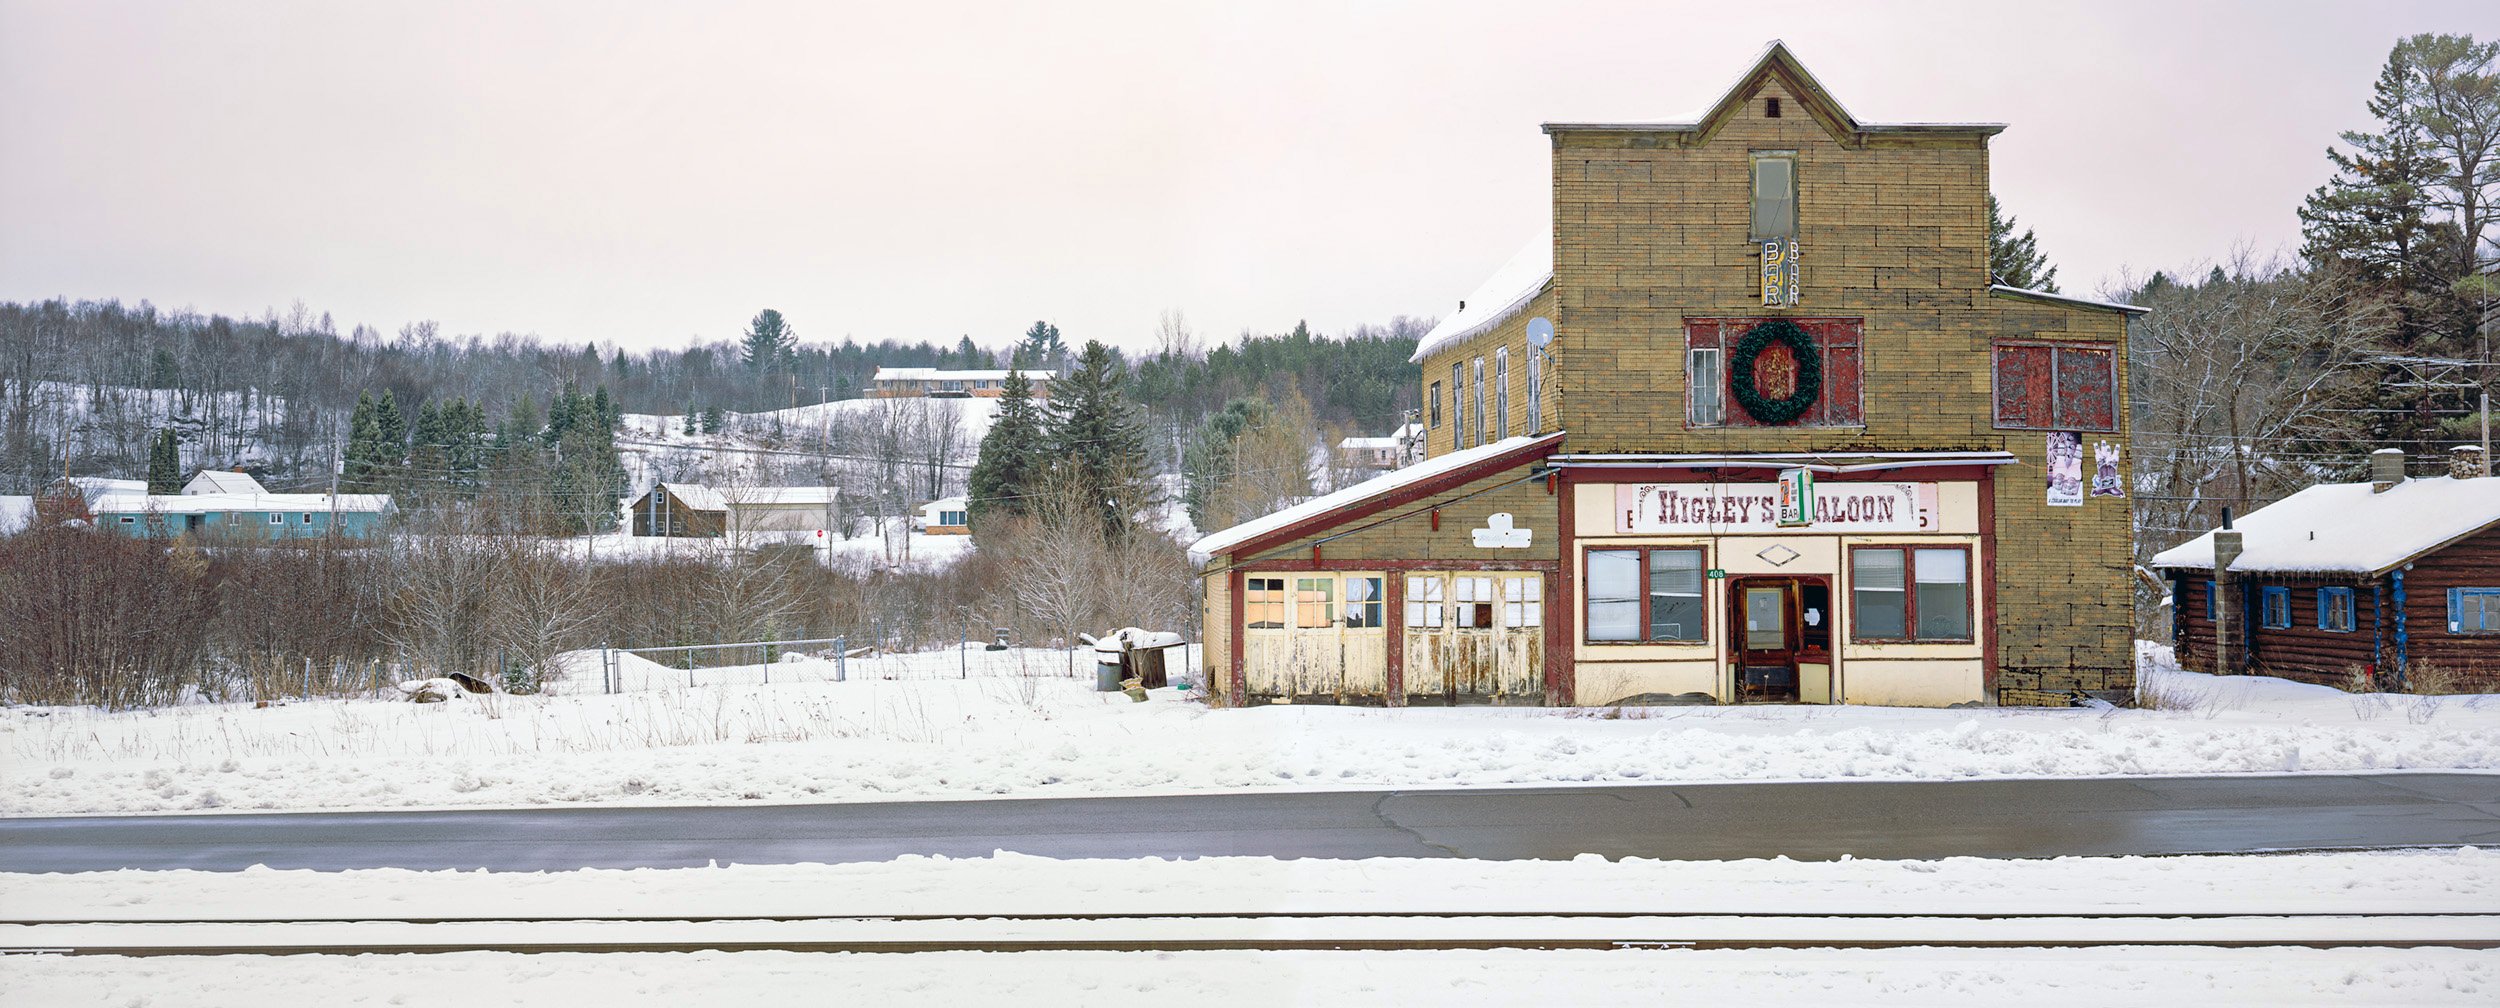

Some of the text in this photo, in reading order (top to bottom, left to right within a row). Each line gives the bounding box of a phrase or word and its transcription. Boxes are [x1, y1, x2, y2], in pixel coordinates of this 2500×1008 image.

[1765, 242, 1779, 304] BAR
[1790, 242, 1799, 305] BAR
[1658, 490, 1775, 524] HIGLEY'S
[1815, 495, 1895, 523] ALOON
[1709, 570, 1724, 578] 408
